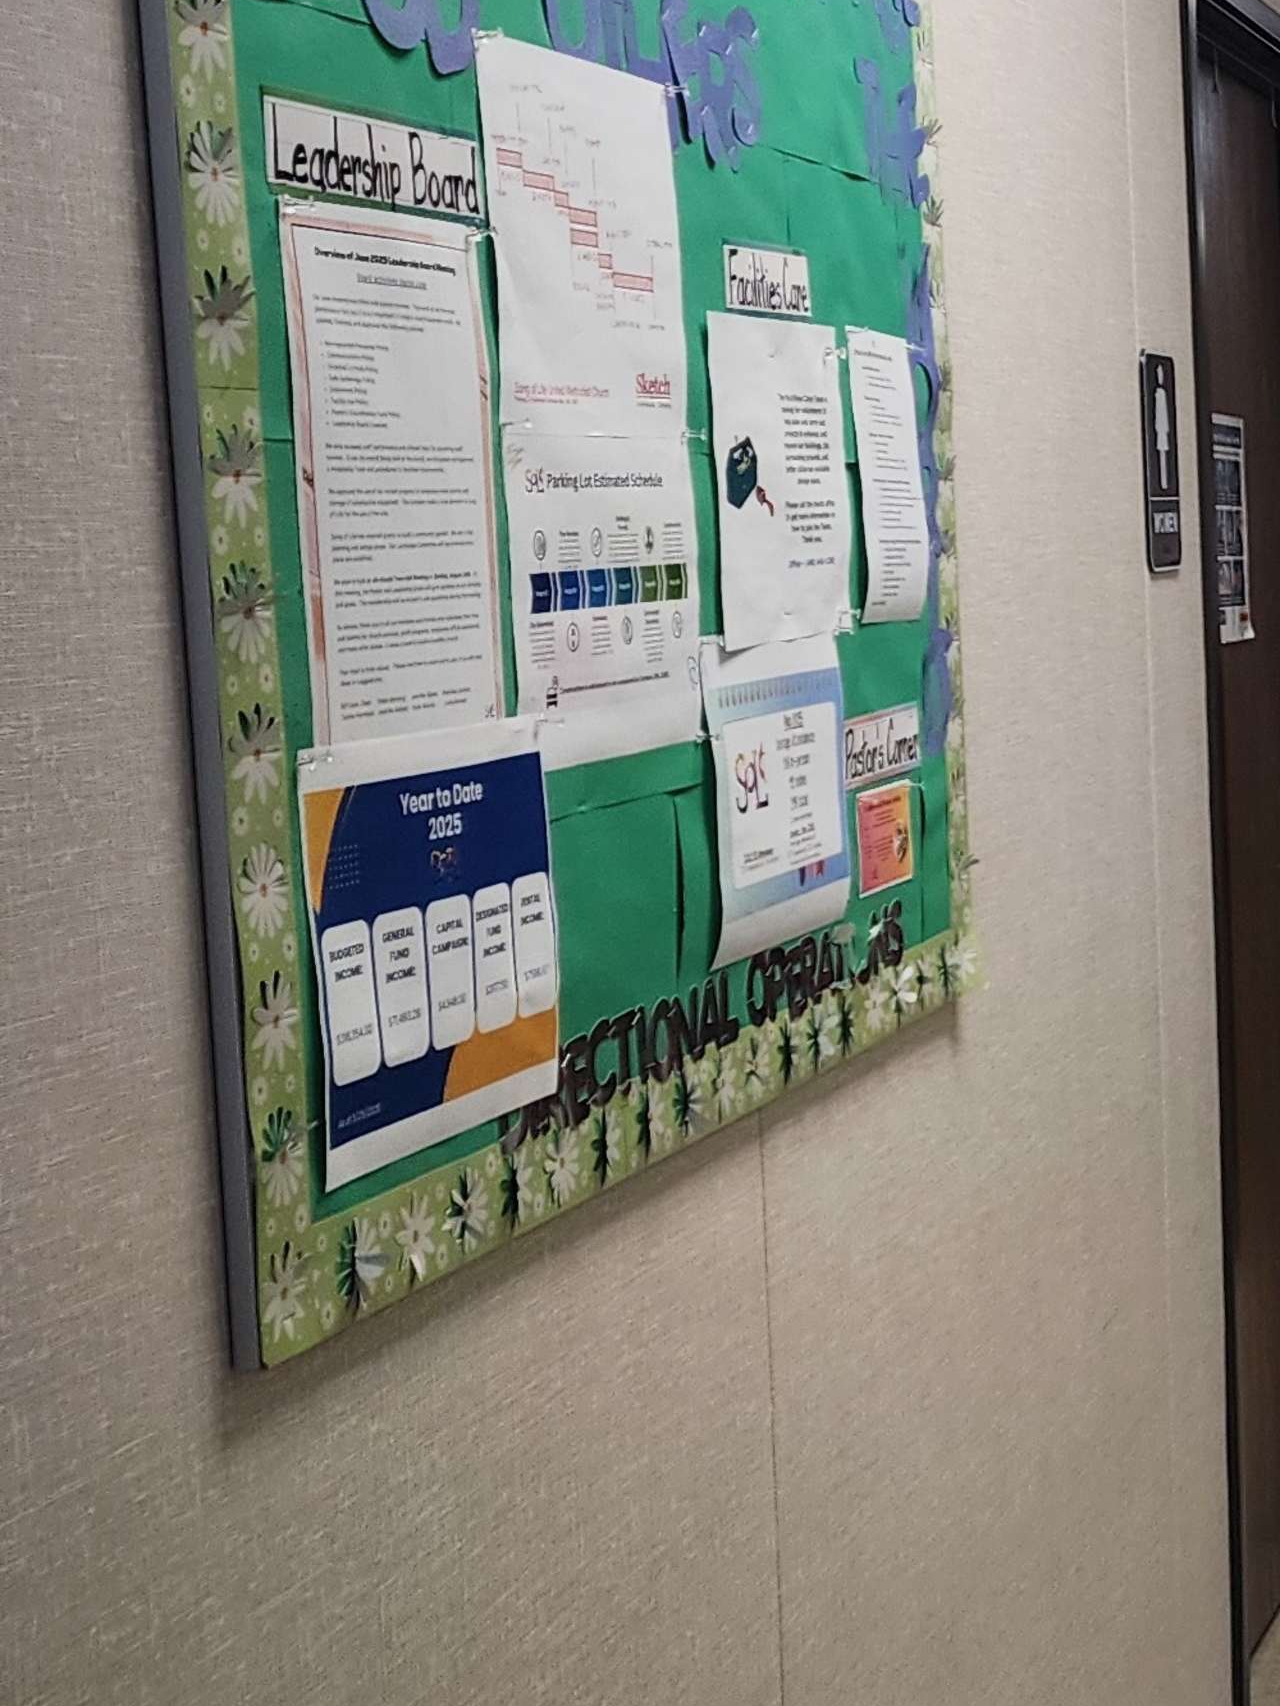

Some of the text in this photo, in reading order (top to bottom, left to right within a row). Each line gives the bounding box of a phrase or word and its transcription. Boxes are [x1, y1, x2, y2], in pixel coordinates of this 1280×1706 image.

[273, 102, 480, 215] Leadership Board
[728, 248, 781, 311] Facilities
[636, 373, 671, 396] Sketch
[546, 473, 578, 493] Parking
[400, 782, 483, 816] Year to Date
[428, 813, 463, 840] 2025
[382, 926, 415, 944] GENERAL
[436, 918, 464, 935] CAPITAL
[329, 942, 365, 964] BUDGETED
[389, 946, 410, 964] FUND
